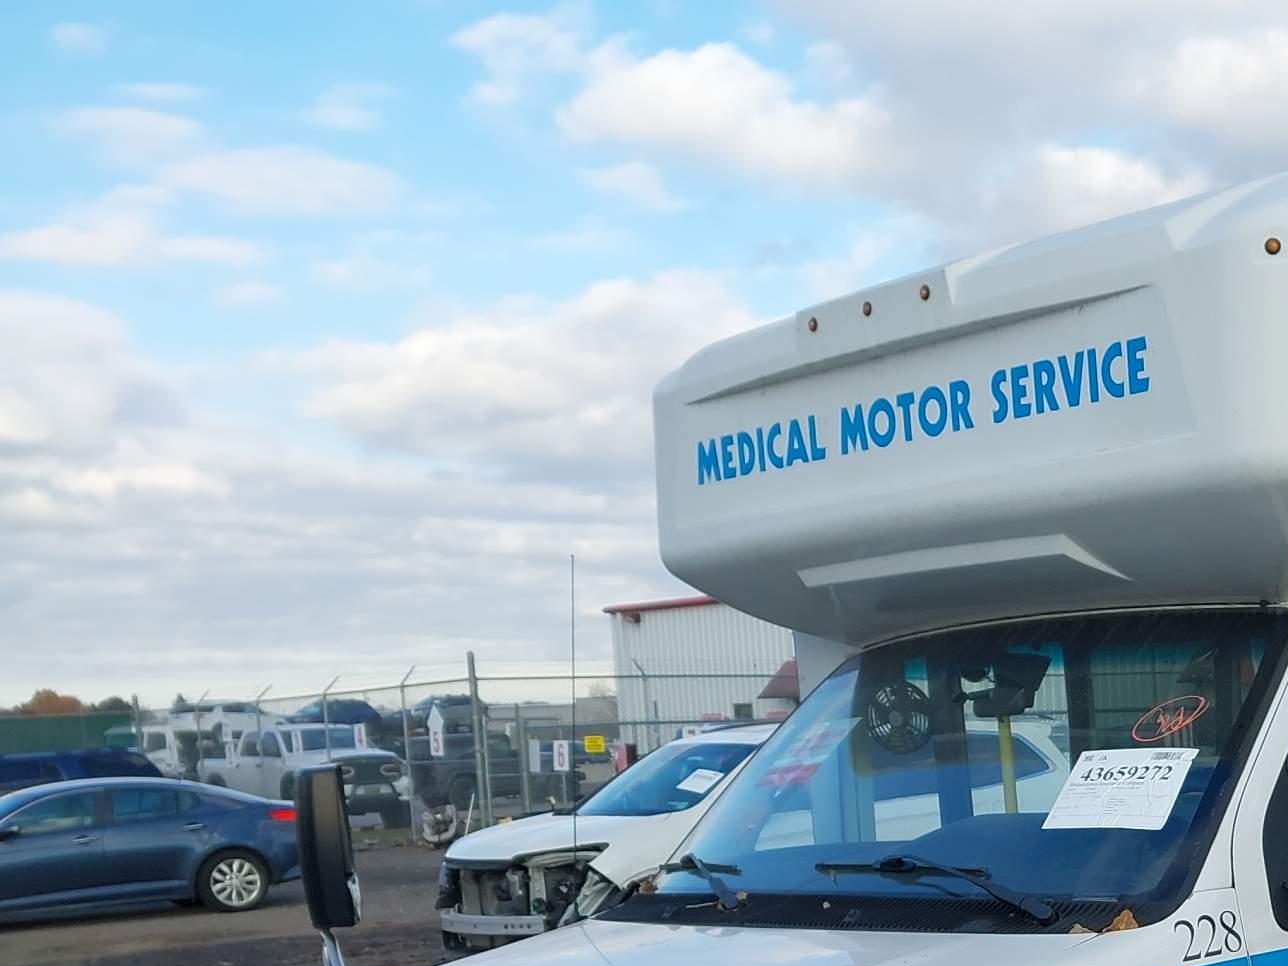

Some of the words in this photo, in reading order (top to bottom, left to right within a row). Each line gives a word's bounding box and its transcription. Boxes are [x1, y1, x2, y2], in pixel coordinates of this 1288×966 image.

[697, 414, 827, 485] MEDICAL
[840, 380, 975, 456] MOTOR
[991, 336, 1151, 424] SERVICE
[1081, 765, 1173, 782] 43659272
[1173, 910, 1242, 963] 228
